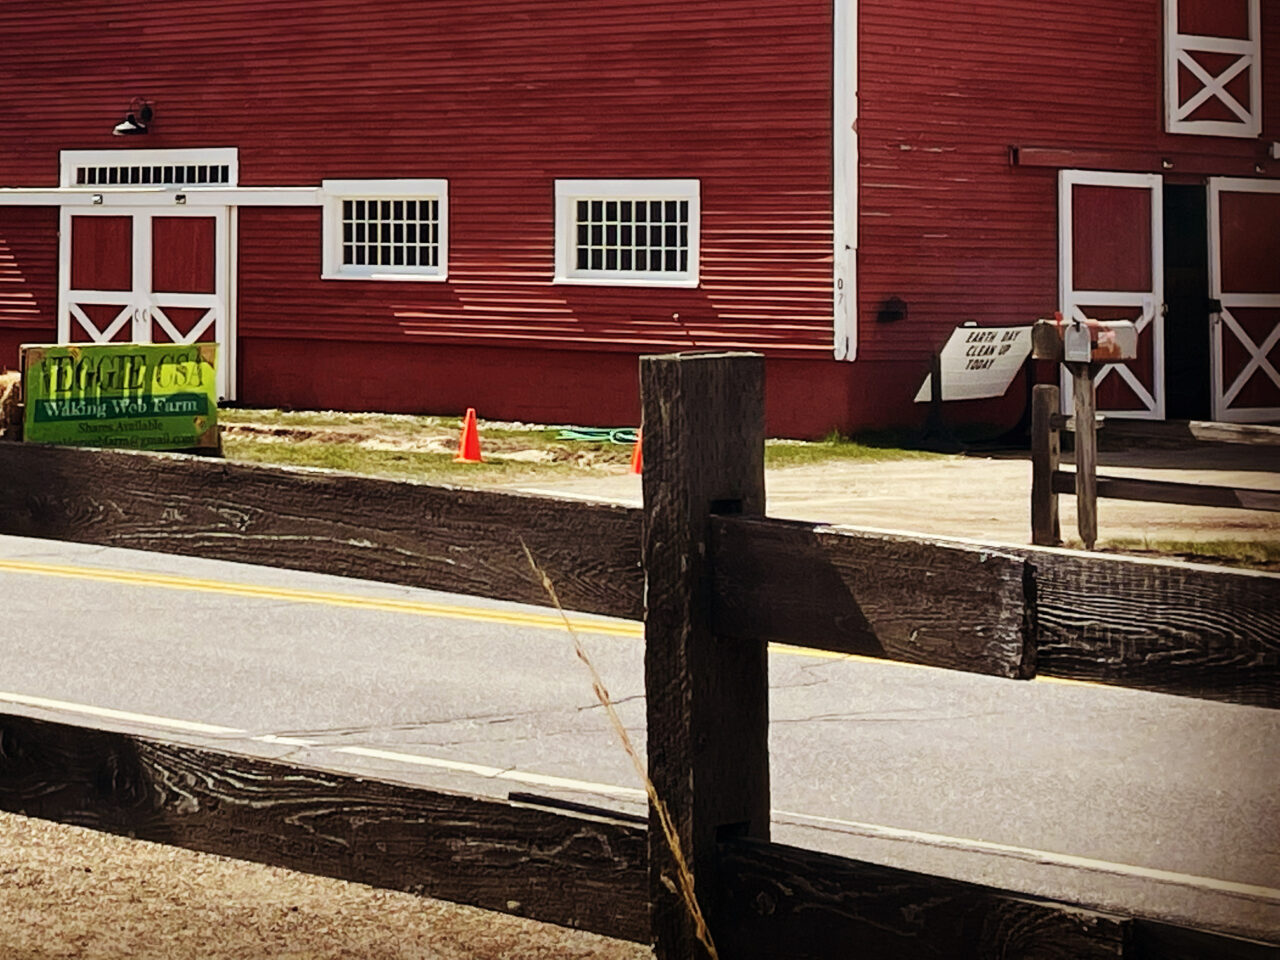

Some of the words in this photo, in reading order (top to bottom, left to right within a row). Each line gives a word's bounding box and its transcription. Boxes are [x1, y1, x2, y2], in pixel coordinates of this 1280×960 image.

[965, 331, 998, 343] EARTH
[1001, 331, 1021, 342] DAY
[966, 345, 997, 357] CLEAN
[998, 344, 1011, 356] UP
[965, 358, 996, 370] TODAY
[43, 400, 107, 419] Waking
[113, 398, 148, 414] Web
[153, 397, 199, 413] Farm
